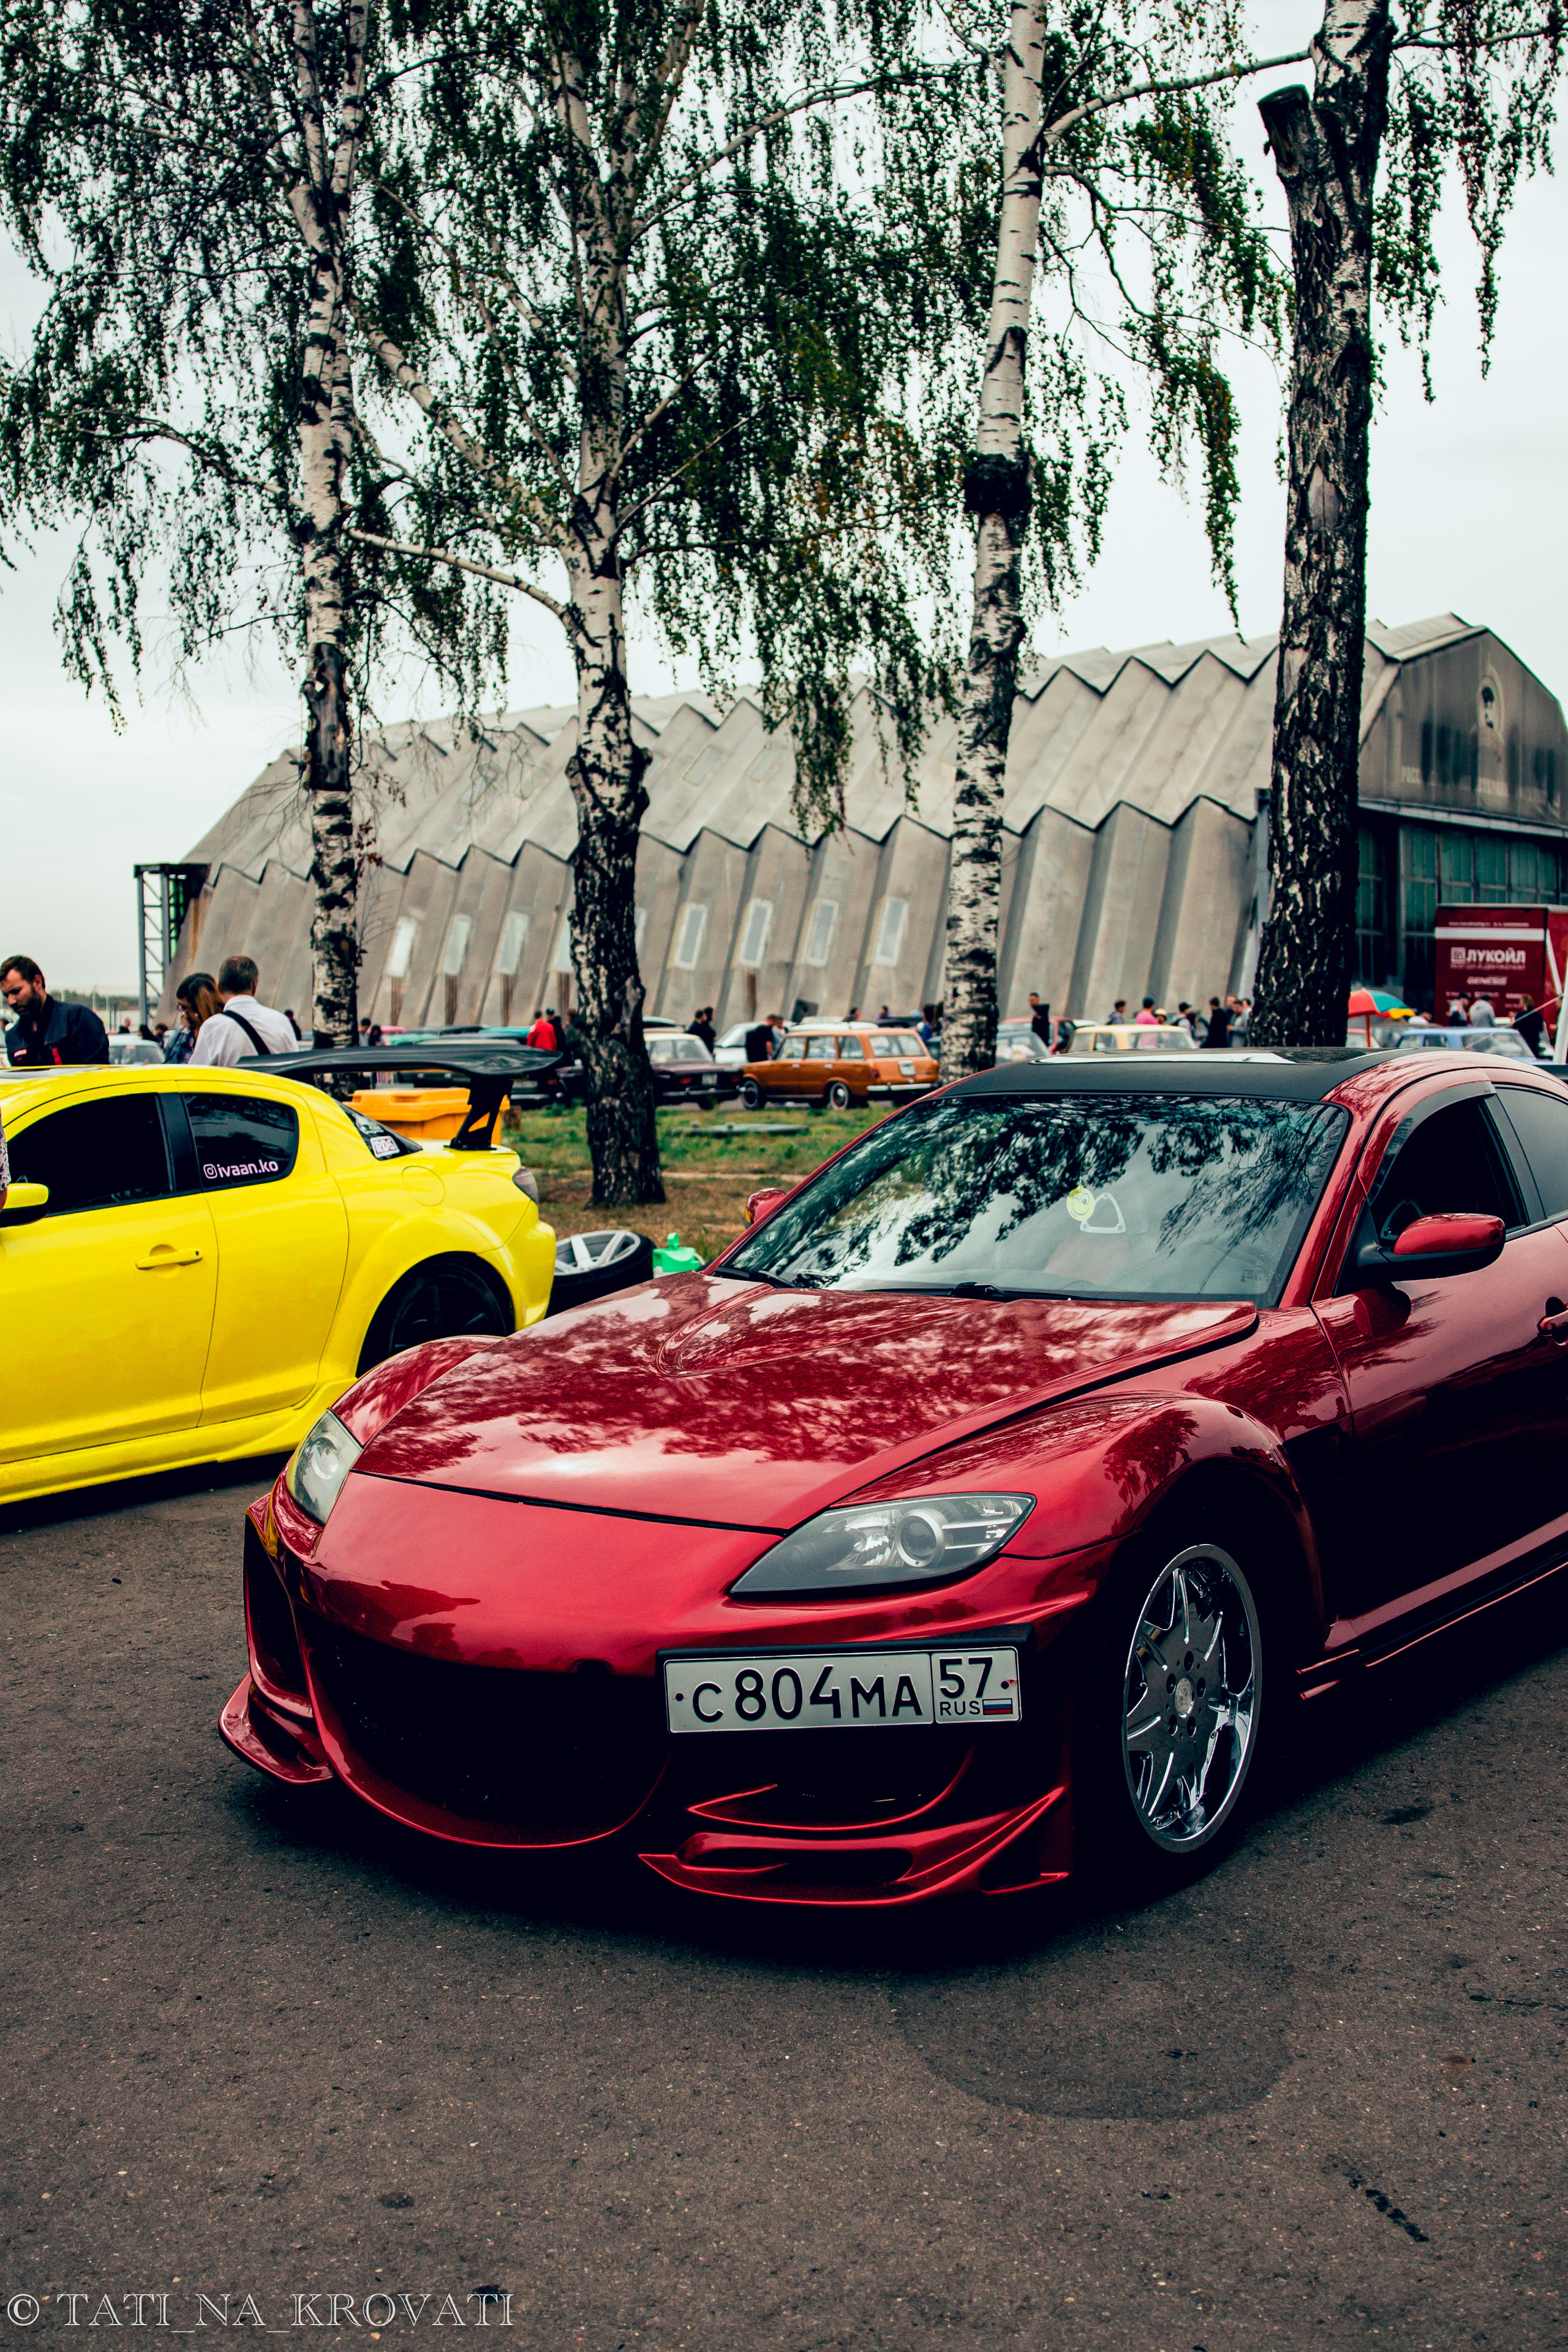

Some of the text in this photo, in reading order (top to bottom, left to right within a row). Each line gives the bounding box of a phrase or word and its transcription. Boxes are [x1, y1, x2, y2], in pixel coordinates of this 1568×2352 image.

[1466, 947, 1526, 963] ЛУКОЙЛ
[217, 1159, 279, 1177] ivaan.ko
[939, 1656, 993, 1698] 57
[940, 1700, 981, 1716] RUS
